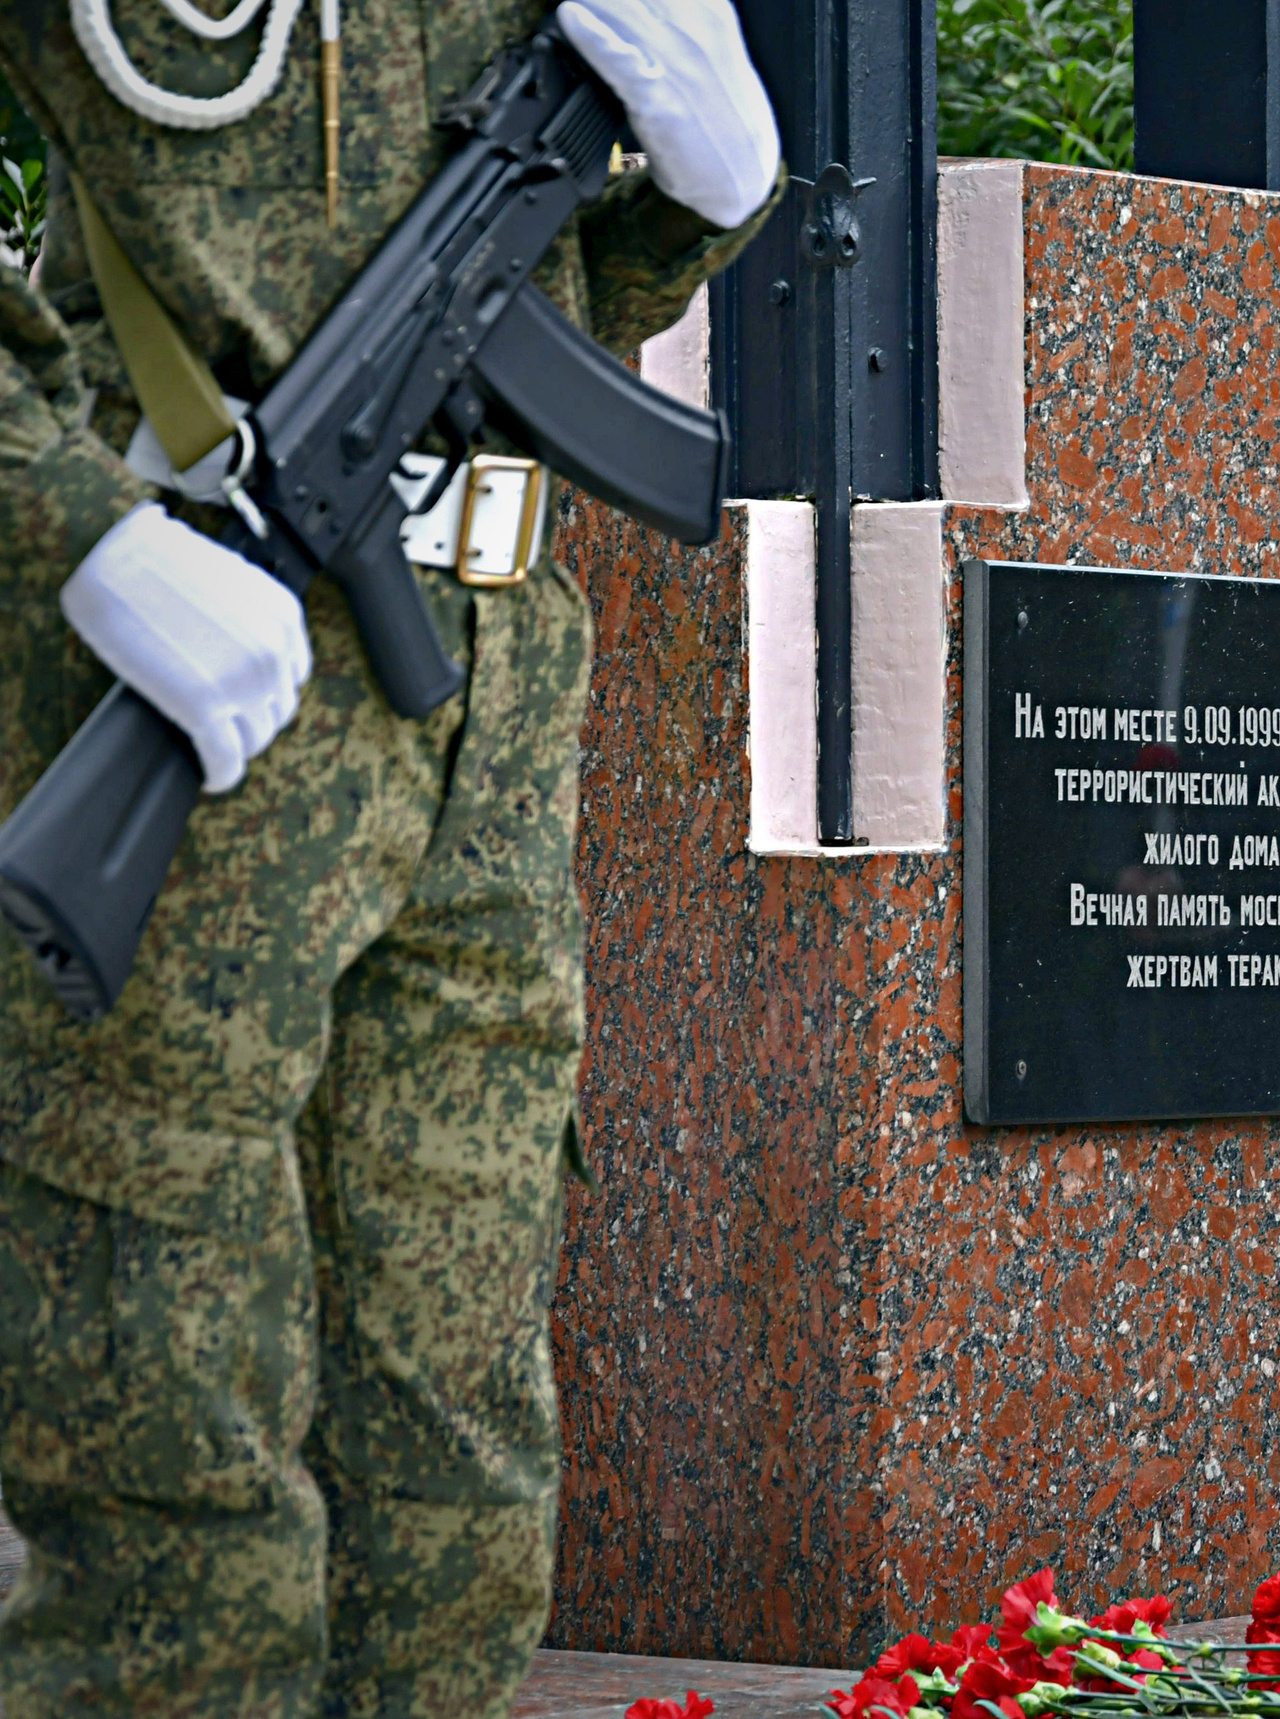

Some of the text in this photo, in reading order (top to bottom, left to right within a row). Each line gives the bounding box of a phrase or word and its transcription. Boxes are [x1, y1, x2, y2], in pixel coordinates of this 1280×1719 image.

[1053, 705, 1108, 741] ЭТОМ
[1113, 707, 1178, 744] МЕСТЕ
[1054, 759, 1249, 806] ТЕРРОРИСТИЧЕСКИЙ
[1142, 832, 1220, 867] ЖИЛОГО
[1156, 893, 1232, 928] ПАМЯТЬ
[1125, 954, 1219, 989] ЖЕРТВАМ
